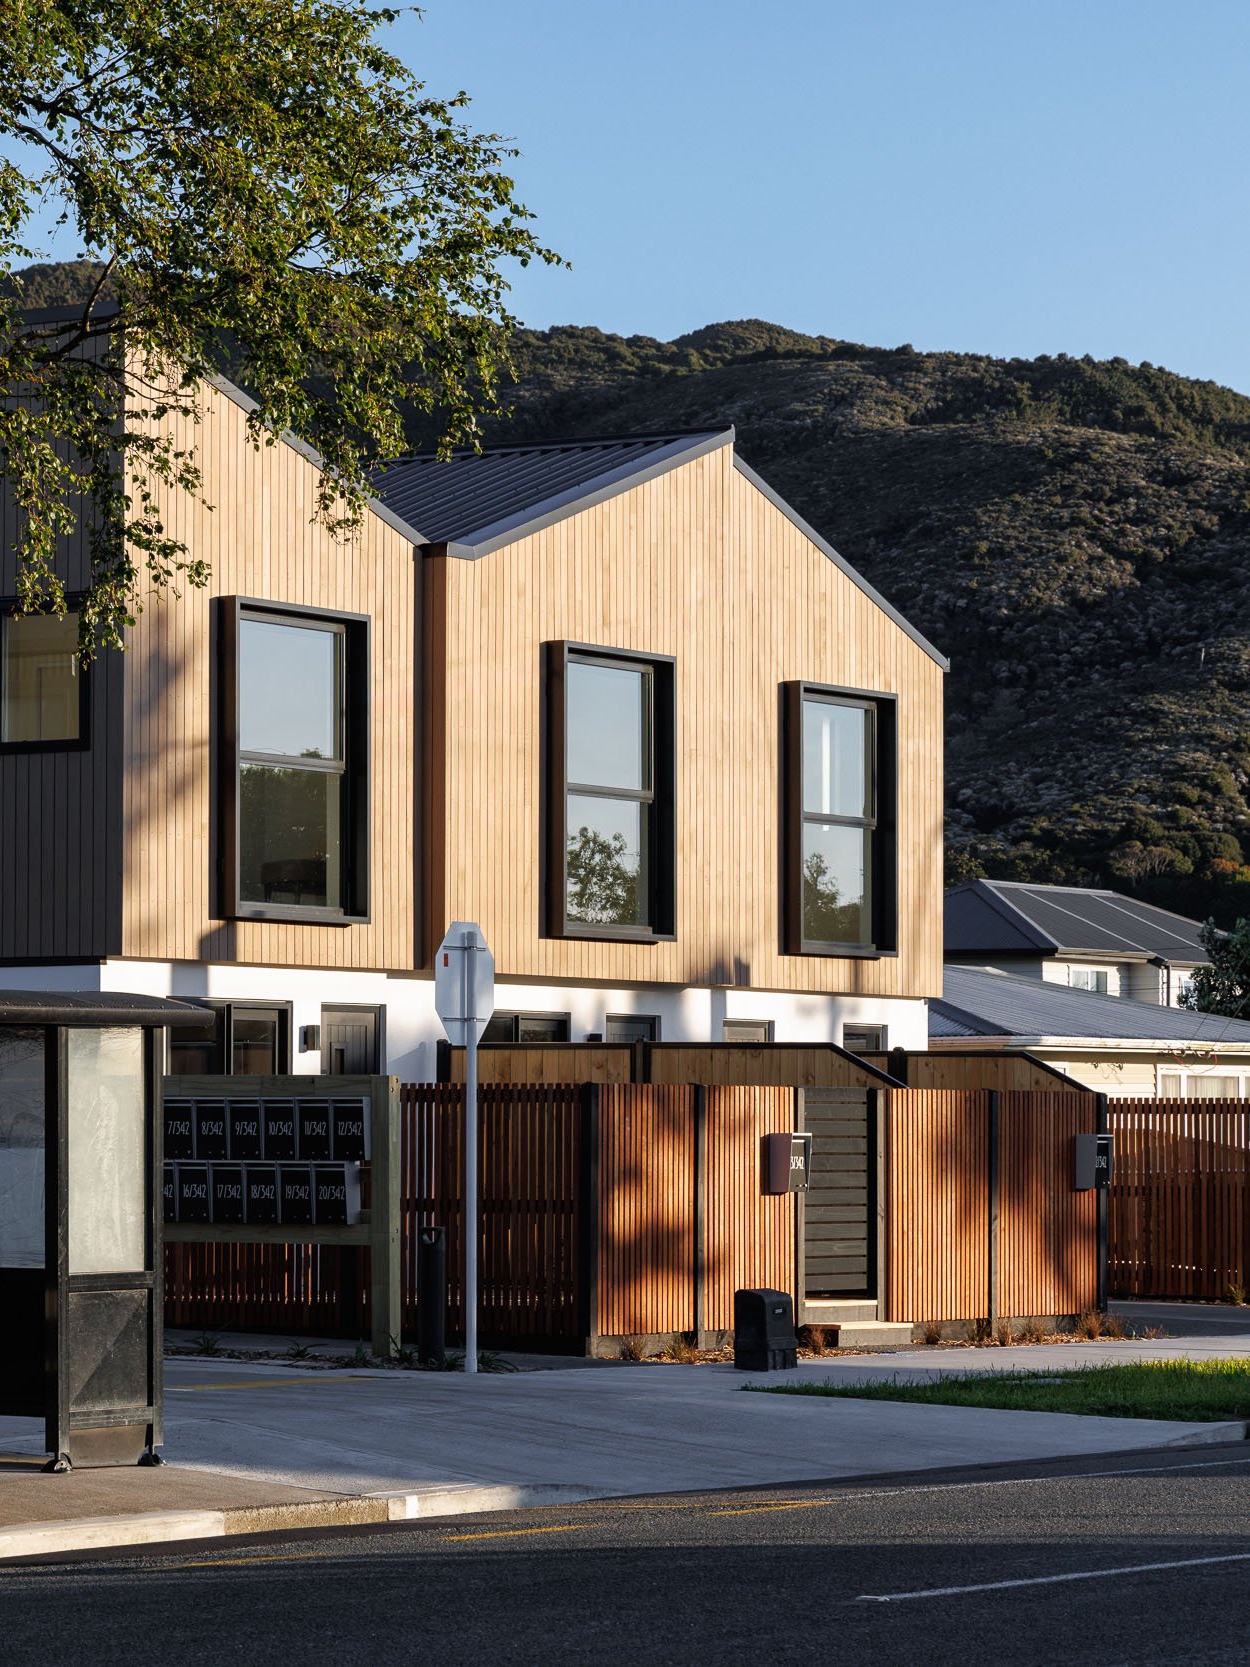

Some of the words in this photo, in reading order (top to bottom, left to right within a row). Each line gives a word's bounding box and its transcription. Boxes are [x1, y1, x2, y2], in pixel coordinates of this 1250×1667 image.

[167, 1121, 190, 1135] 7/342
[201, 1121, 223, 1135] 8/342
[235, 1121, 257, 1136] 9/342
[268, 1121, 293, 1136] 10/342
[304, 1121, 327, 1136] 11/342
[338, 1121, 362, 1136] 12/342
[183, 1183, 207, 1198] 16/342
[217, 1184, 241, 1199] 17/342
[250, 1184, 275, 1199] 18/342
[285, 1185, 309, 1199] 19/342
[318, 1186, 345, 1200] 20/342
